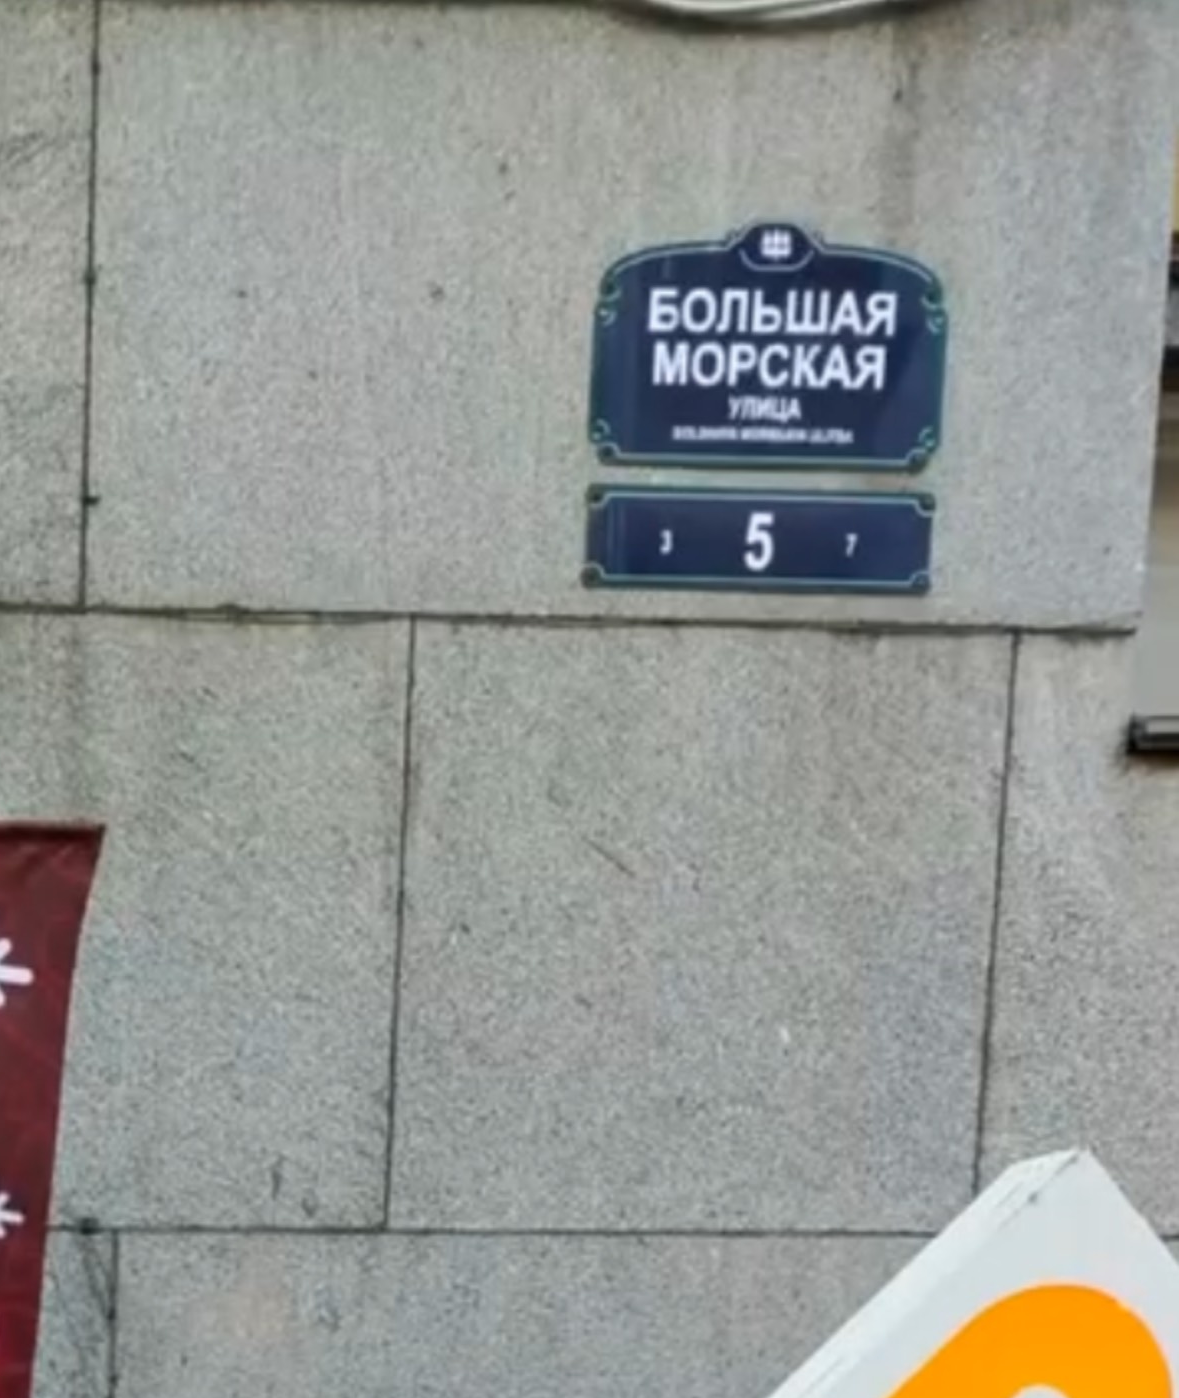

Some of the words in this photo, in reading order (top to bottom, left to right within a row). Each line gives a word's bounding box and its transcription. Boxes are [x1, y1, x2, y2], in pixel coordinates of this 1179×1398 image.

[646, 287, 899, 337] БОЛЬШАЯ
[651, 341, 888, 390] МОРСКАЯ
[728, 394, 802, 423] УЛИЦА
[660, 530, 673, 554] 3
[743, 511, 776, 571] 5
[845, 533, 858, 556] 7
